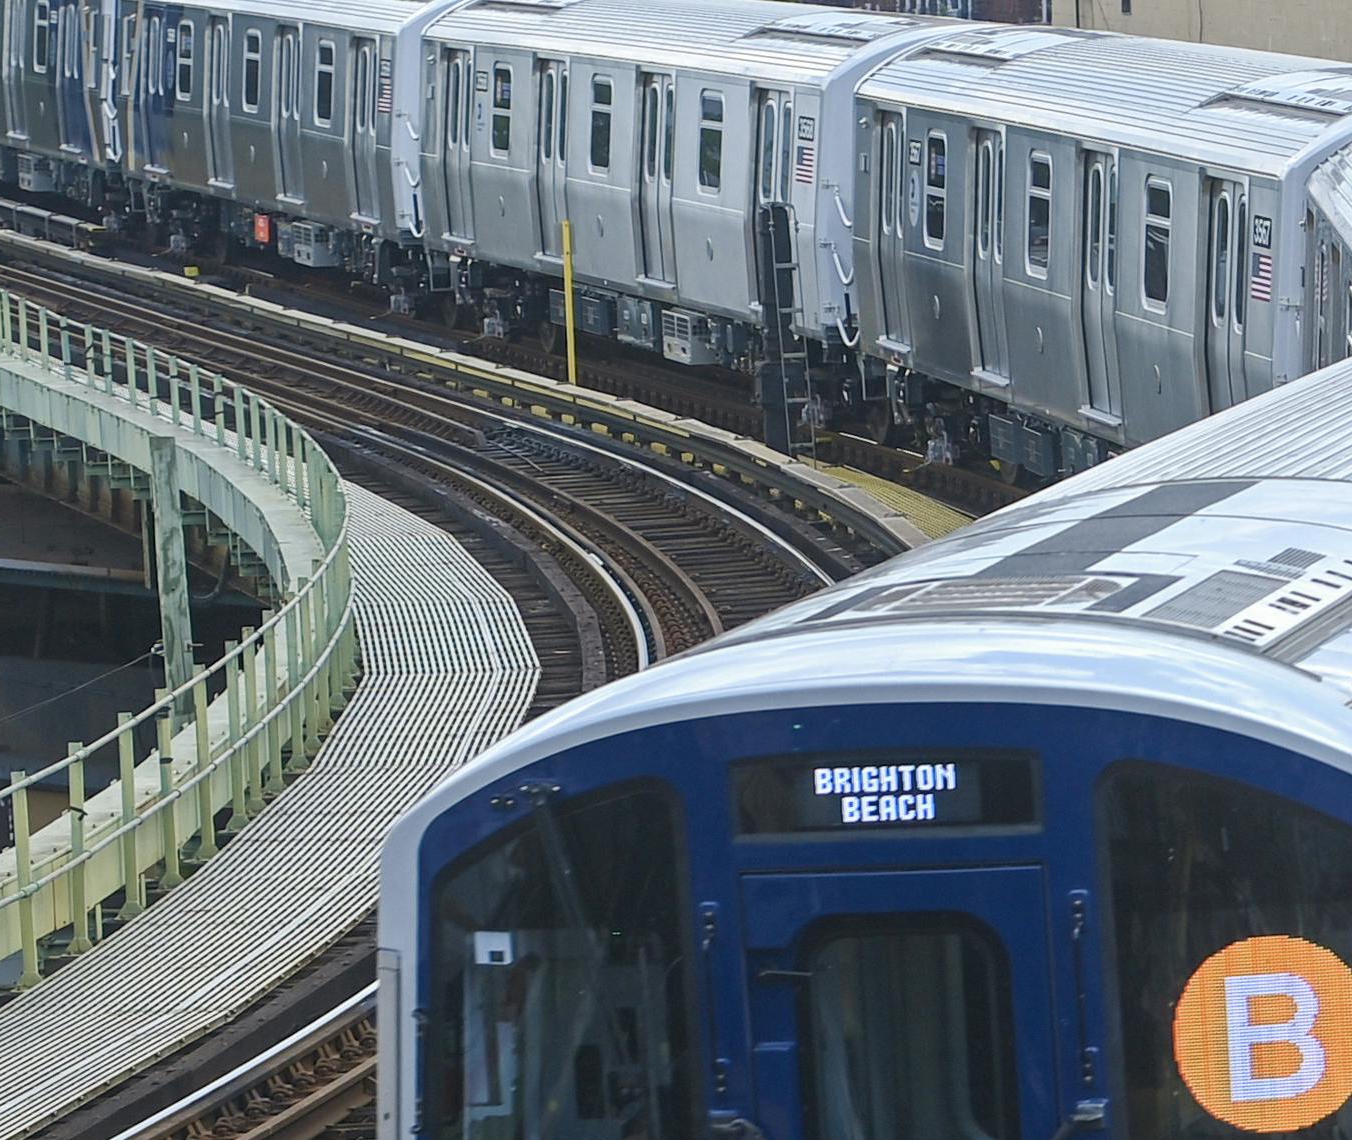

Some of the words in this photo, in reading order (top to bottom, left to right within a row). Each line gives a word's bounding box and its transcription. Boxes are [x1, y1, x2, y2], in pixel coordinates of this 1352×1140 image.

[1254, 218, 1270, 246] 3567
[814, 763, 956, 796] BRIGHTON
[841, 793, 936, 823] BEACH
[1225, 973, 1325, 1102] B
